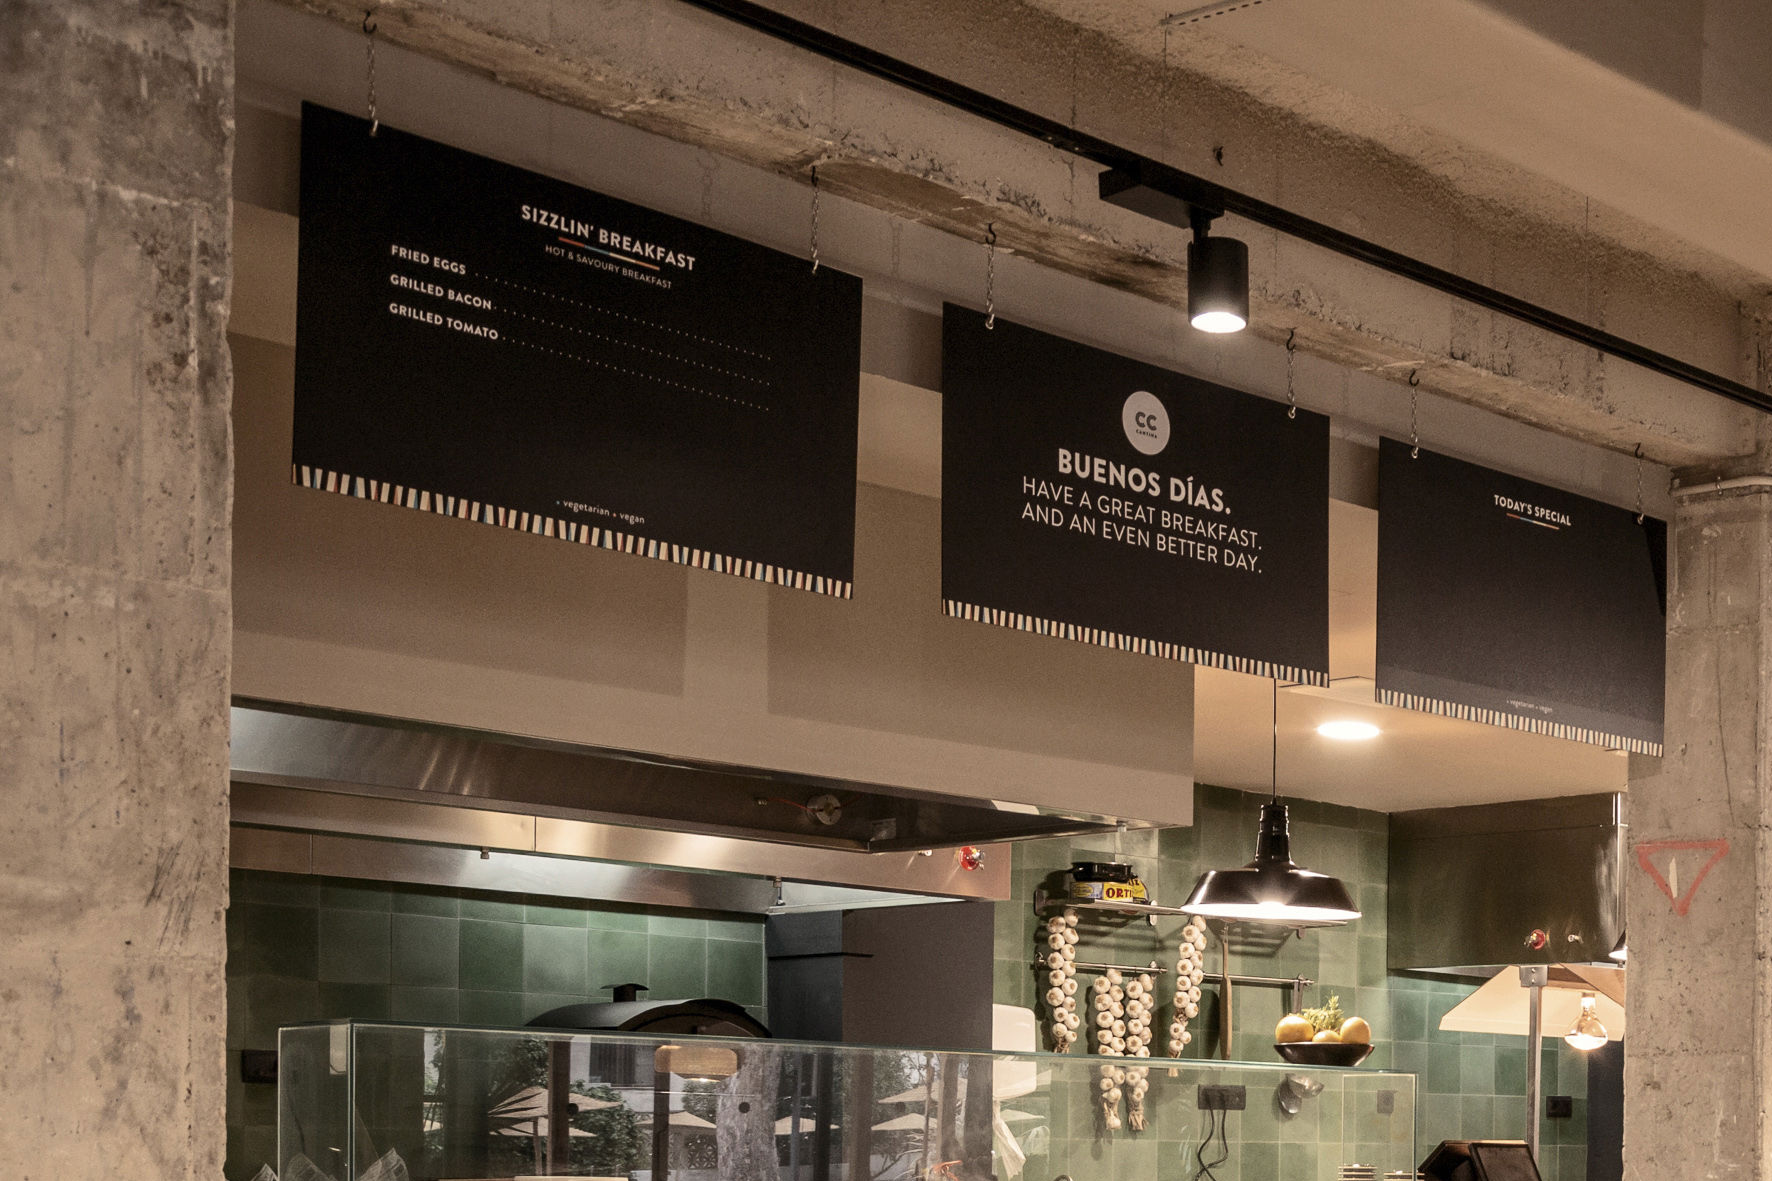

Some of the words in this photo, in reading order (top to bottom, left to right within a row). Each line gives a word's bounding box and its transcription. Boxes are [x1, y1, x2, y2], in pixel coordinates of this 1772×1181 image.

[521, 203, 594, 239] SIZZLIN'
[599, 228, 696, 271] BREAKFAST
[391, 244, 430, 265] FRIED
[433, 256, 466, 276] EGGS
[545, 244, 565, 258] HOT
[567, 251, 574, 261] &
[576, 252, 620, 274] SAVOURY
[622, 267, 672, 289] BREAKFAST
[390, 273, 444, 297] GRILLED
[447, 289, 492, 311] BACON
[389, 302, 443, 326] GRILLED
[446, 317, 499, 340] TOMATO
[1135, 411, 1157, 431] CC
[1058, 447, 1161, 497] BUENOS
[1169, 476, 1232, 515] DÍAS.
[563, 500, 610, 517] vegetarian
[620, 512, 645, 525] vegan
[1023, 476, 1074, 505] HAVE
[1079, 490, 1093, 511] A
[1097, 495, 1156, 525] GREAT
[1161, 510, 1263, 551] BREAKFAST.
[1493, 494, 1533, 515] TODAY'S
[1534, 506, 1572, 526] SPECIAL
[1022, 502, 1064, 528] AND
[1069, 514, 1096, 536] AN
[1102, 521, 1151, 549] EVEN
[1156, 533, 1218, 564] BETTER
[1224, 549, 1263, 574] DAY.
[1105, 887, 1133, 899] ORTI
